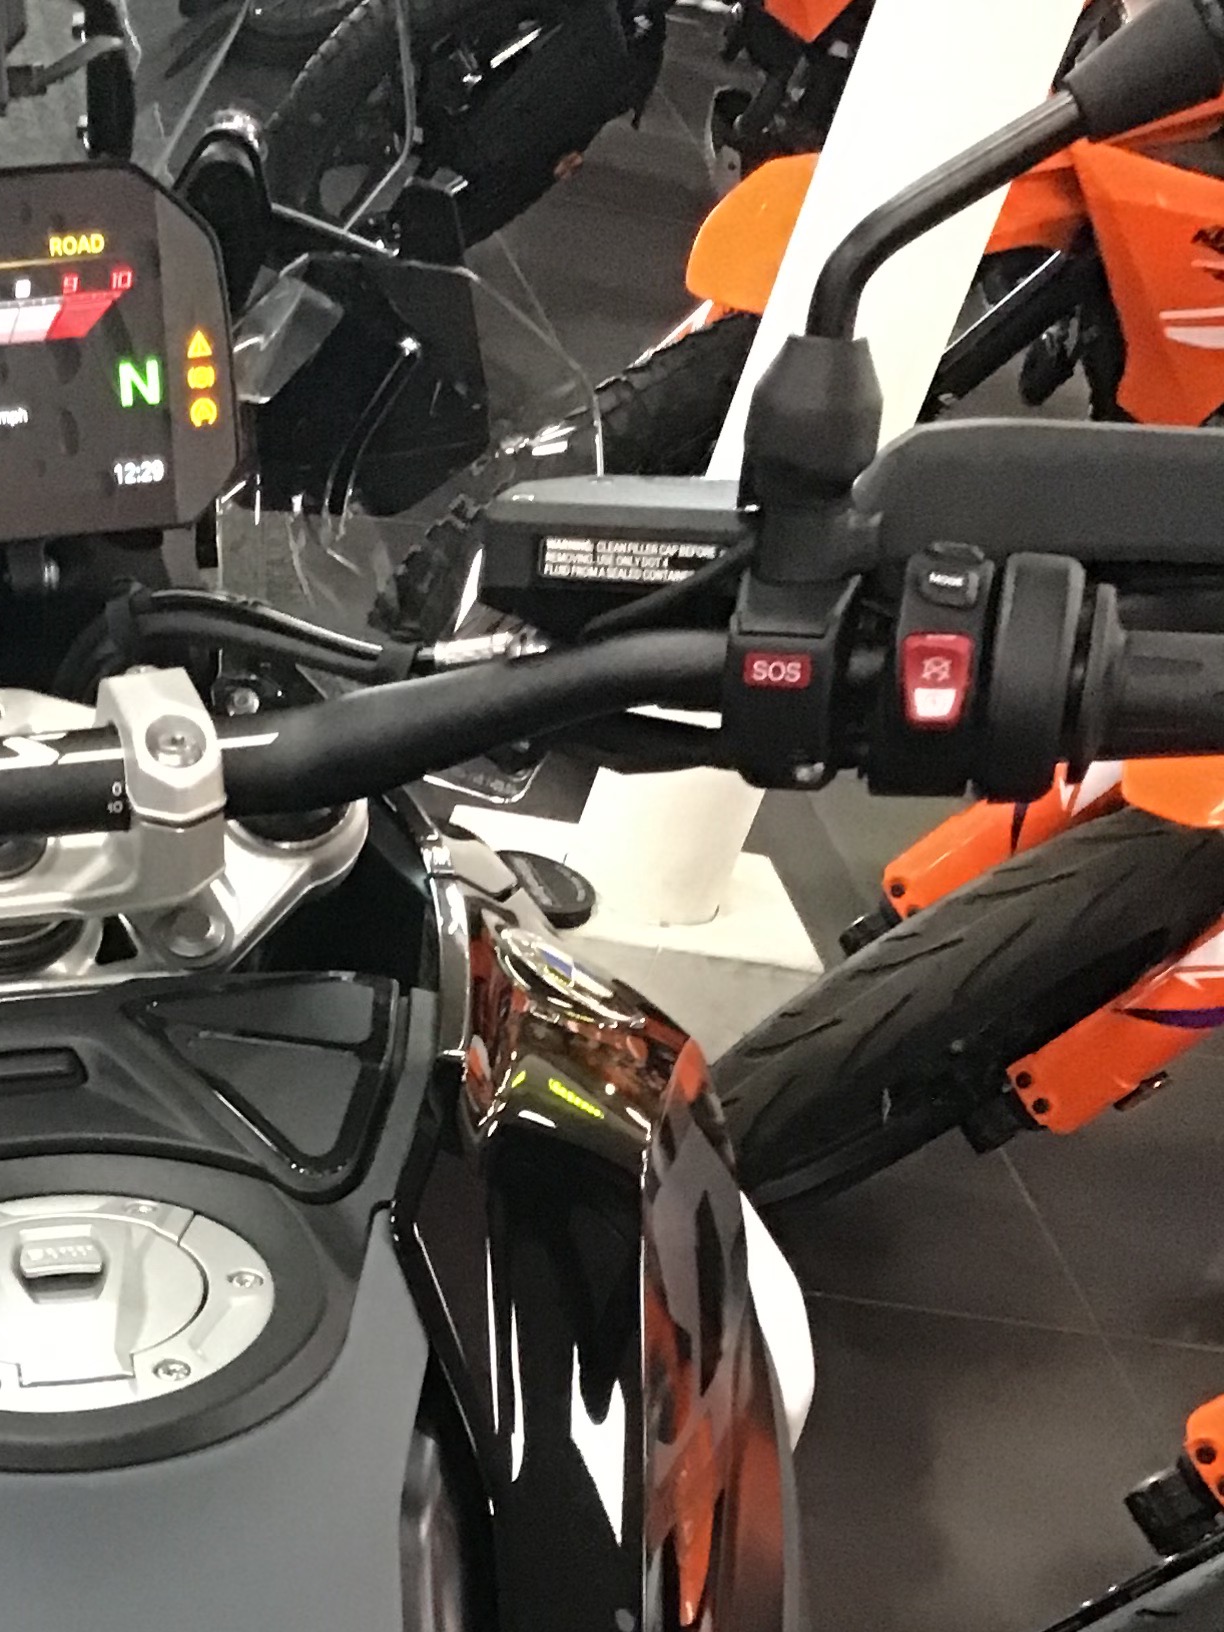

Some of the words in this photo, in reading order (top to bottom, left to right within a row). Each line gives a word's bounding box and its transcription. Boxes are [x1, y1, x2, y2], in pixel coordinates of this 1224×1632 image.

[49, 232, 105, 257] ROAD
[110, 267, 133, 290] 10
[118, 359, 161, 408] N
[597, 541, 627, 553] CLEAN
[628, 542, 658, 554] FILLER
[659, 543, 679, 556] CAP
[679, 545, 716, 559] BEFORE
[544, 563, 570, 576] FLUID
[571, 565, 598, 577] FROM
[598, 566, 606, 578] A
[606, 567, 641, 580] SEALED
[596, 555, 613, 566] USE
[616, 556, 640, 567] ONLY
[641, 557, 662, 568] DOT
[662, 557, 669, 568] 4
[751, 660, 802, 683] SOS
[111, 781, 123, 797] 0
